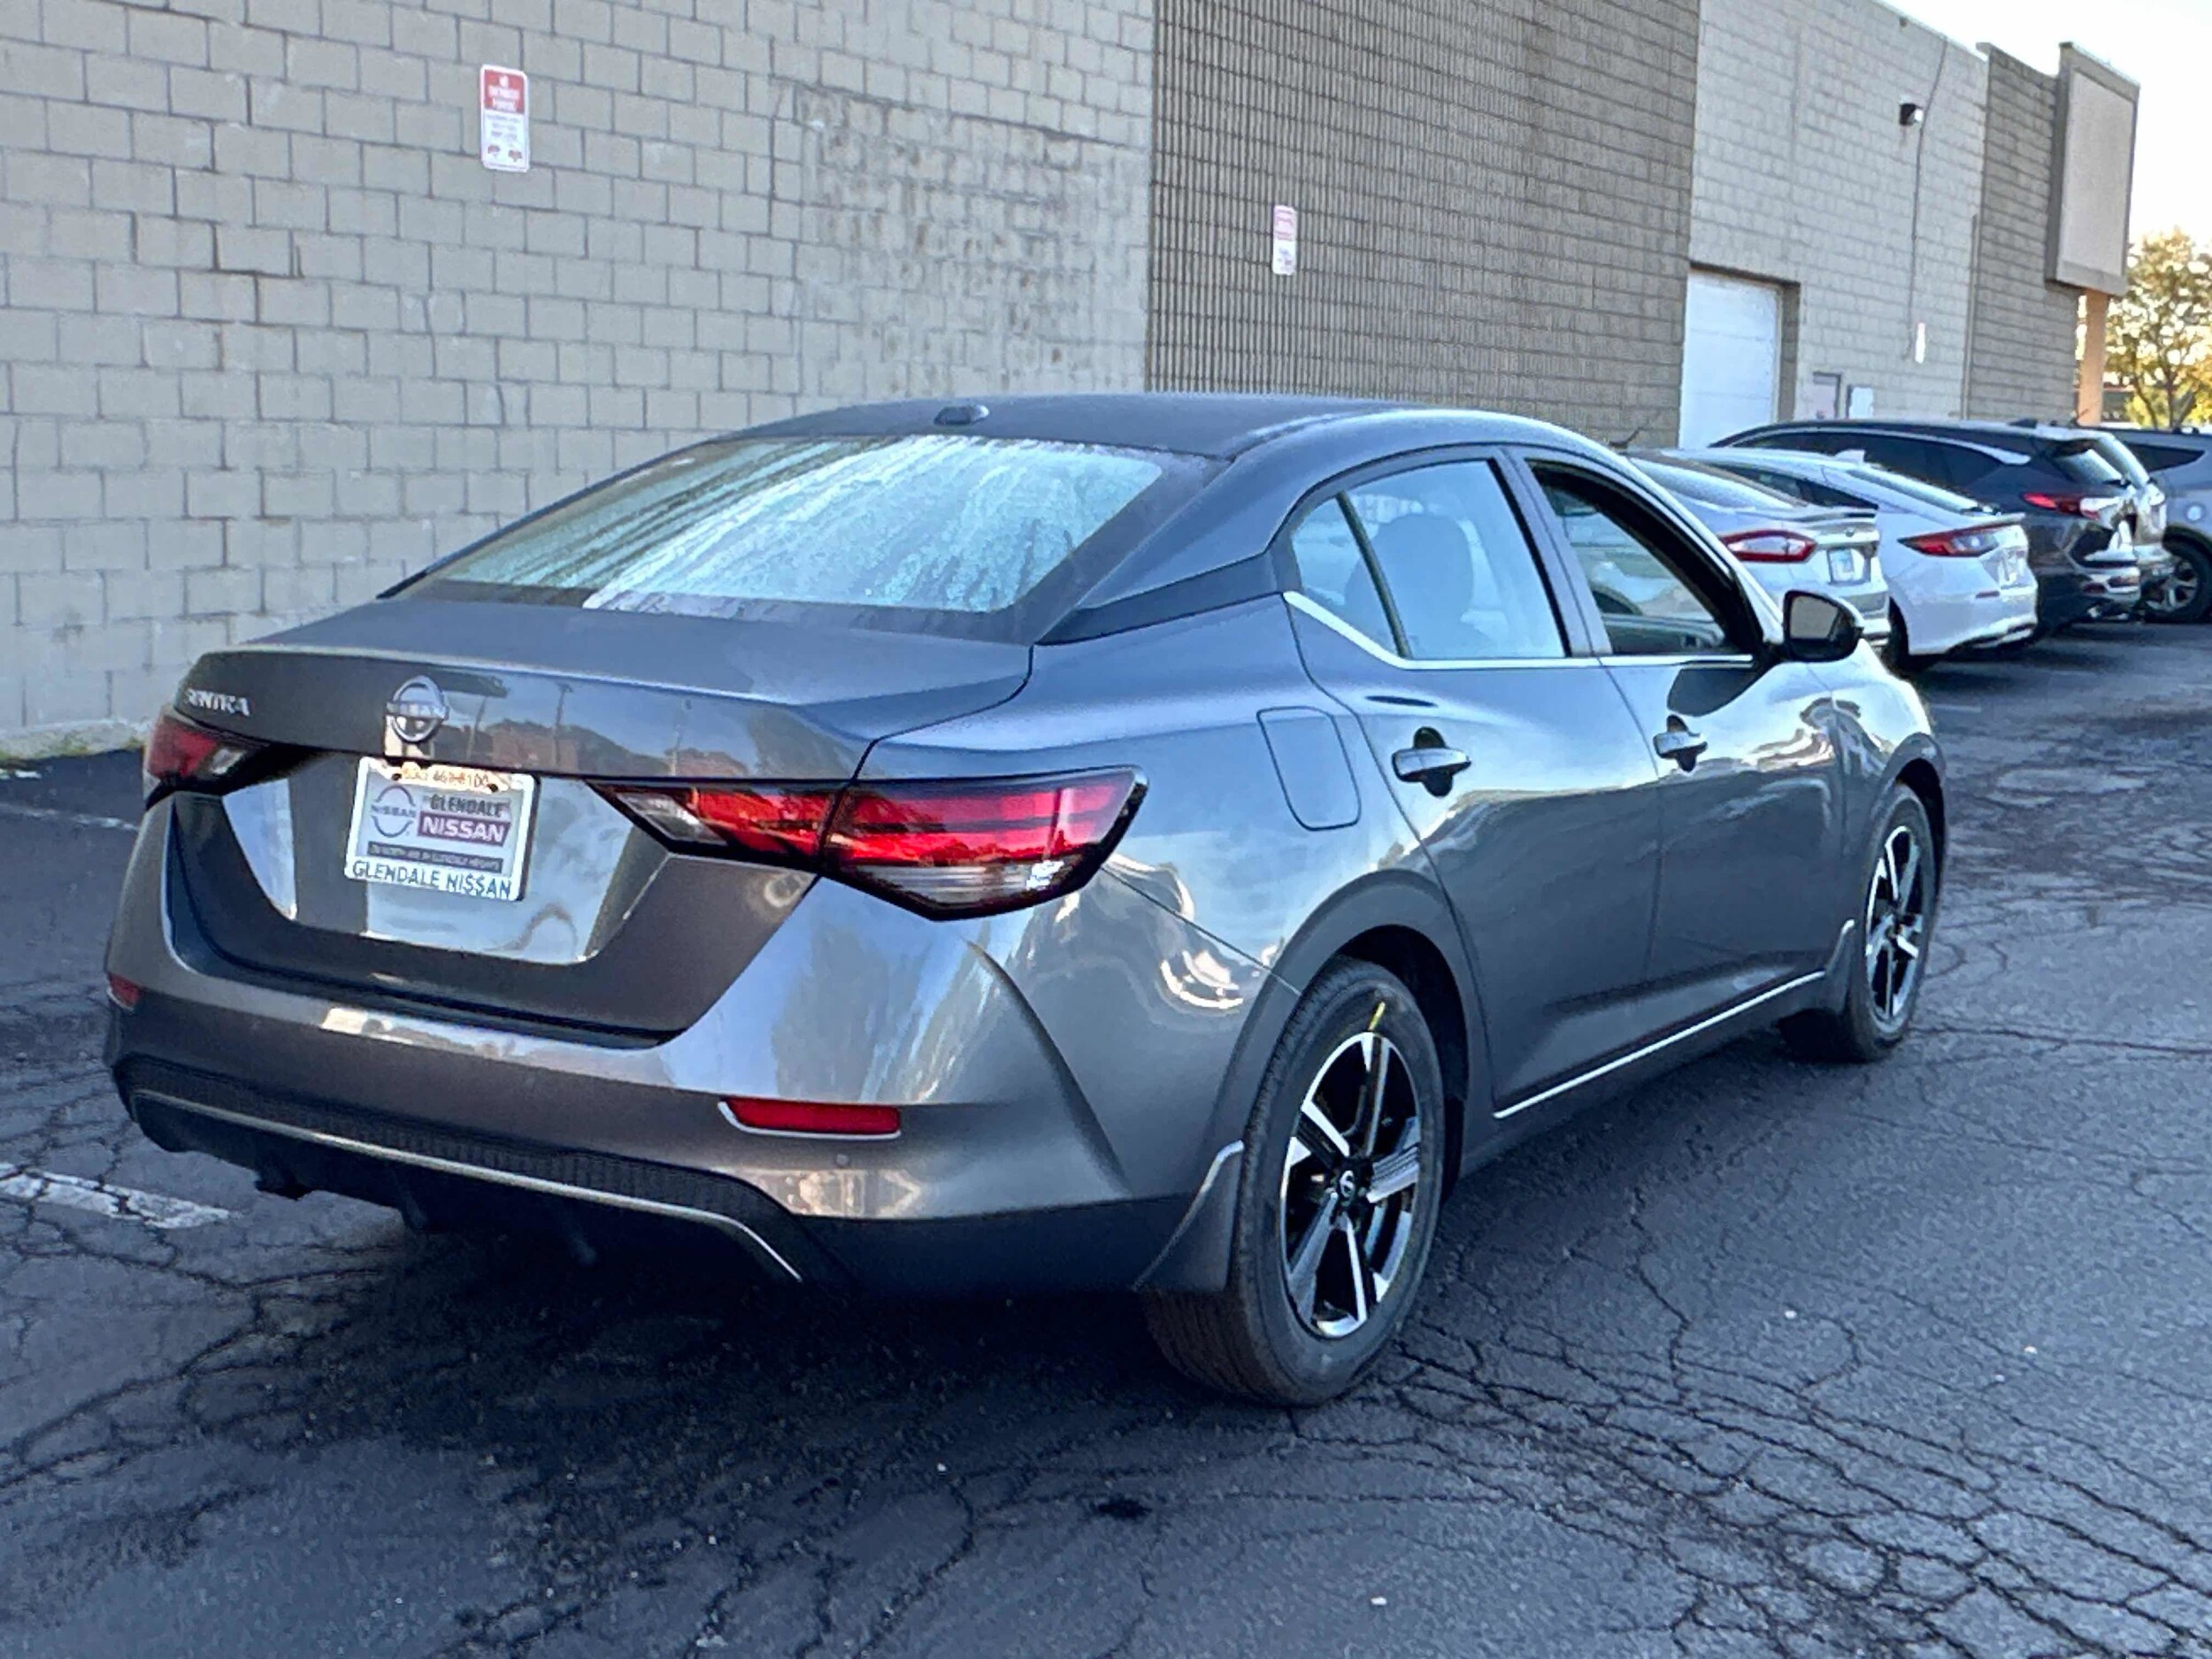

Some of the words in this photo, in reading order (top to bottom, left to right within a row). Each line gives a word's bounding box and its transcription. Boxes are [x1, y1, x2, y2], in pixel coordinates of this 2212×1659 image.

[430, 794, 503, 818] GLENDALE
[420, 816, 505, 841] NISSAN
[352, 859, 440, 887] GLENDALE
[445, 873, 512, 898] NISSAN
